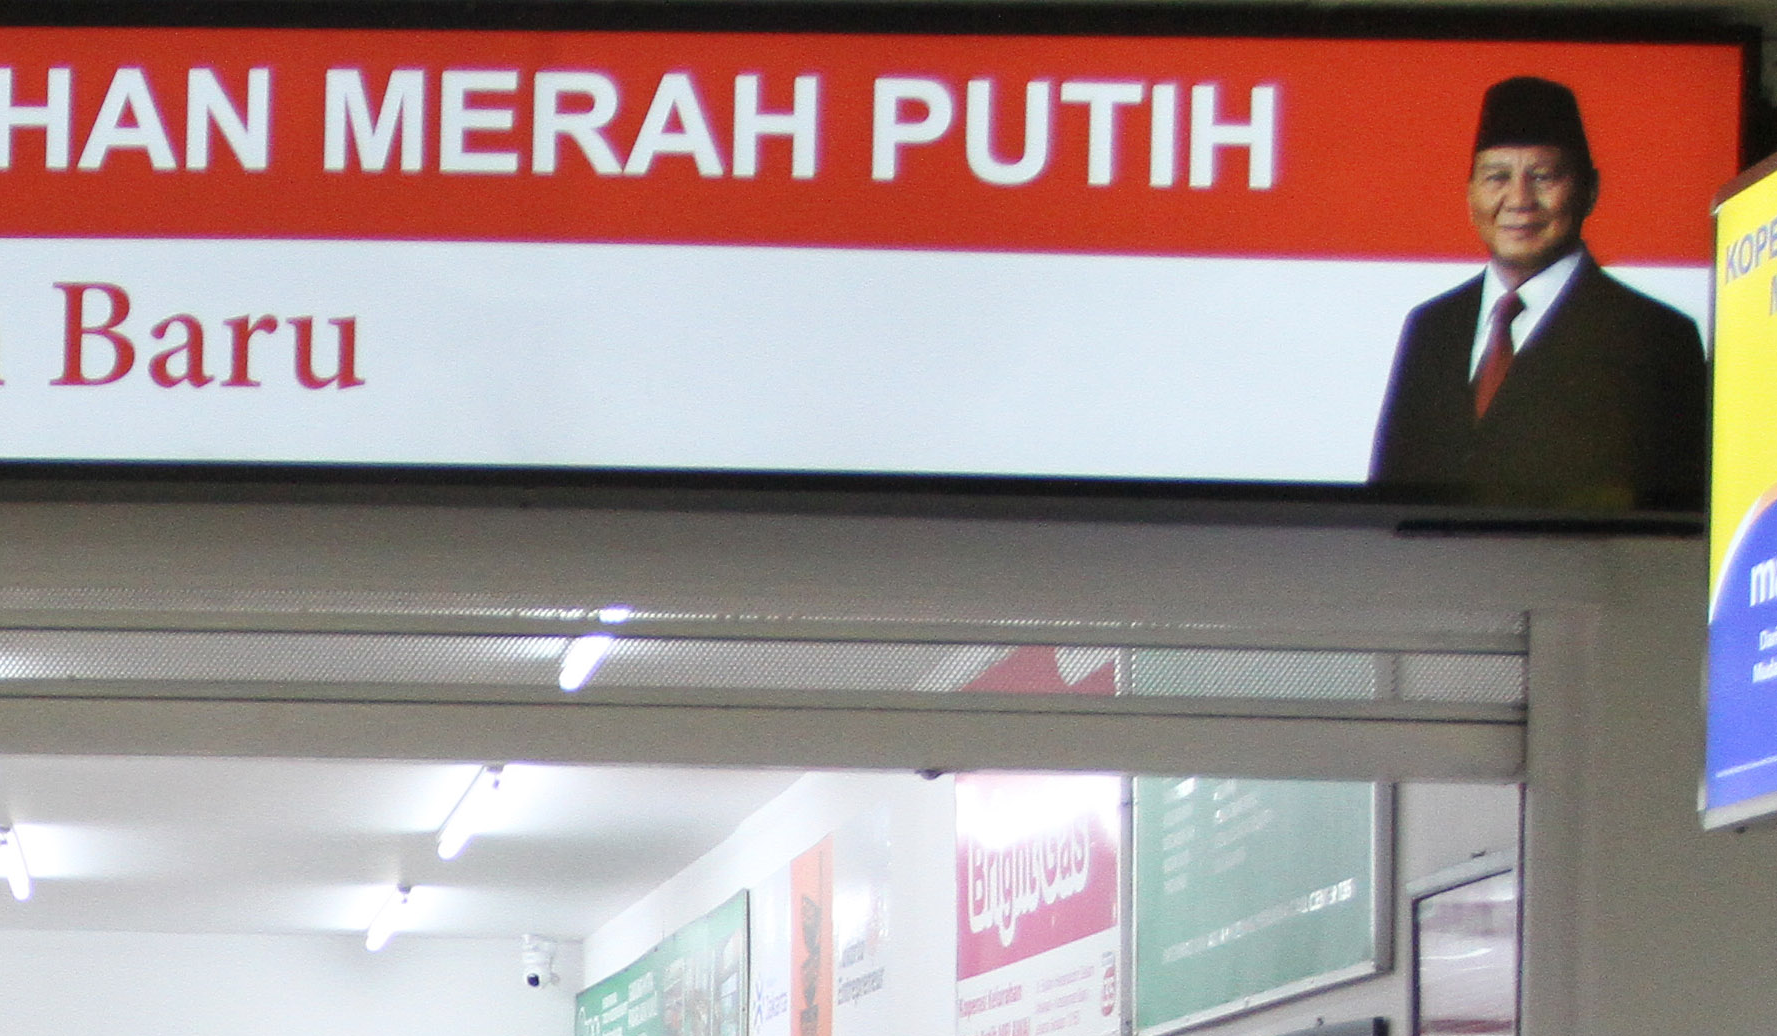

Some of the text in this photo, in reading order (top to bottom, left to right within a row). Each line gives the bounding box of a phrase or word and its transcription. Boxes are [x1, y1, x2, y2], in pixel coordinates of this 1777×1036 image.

[323, 67, 818, 180] MERAH
[873, 76, 1277, 191] PUTIH
[52, 280, 365, 392] Baru
